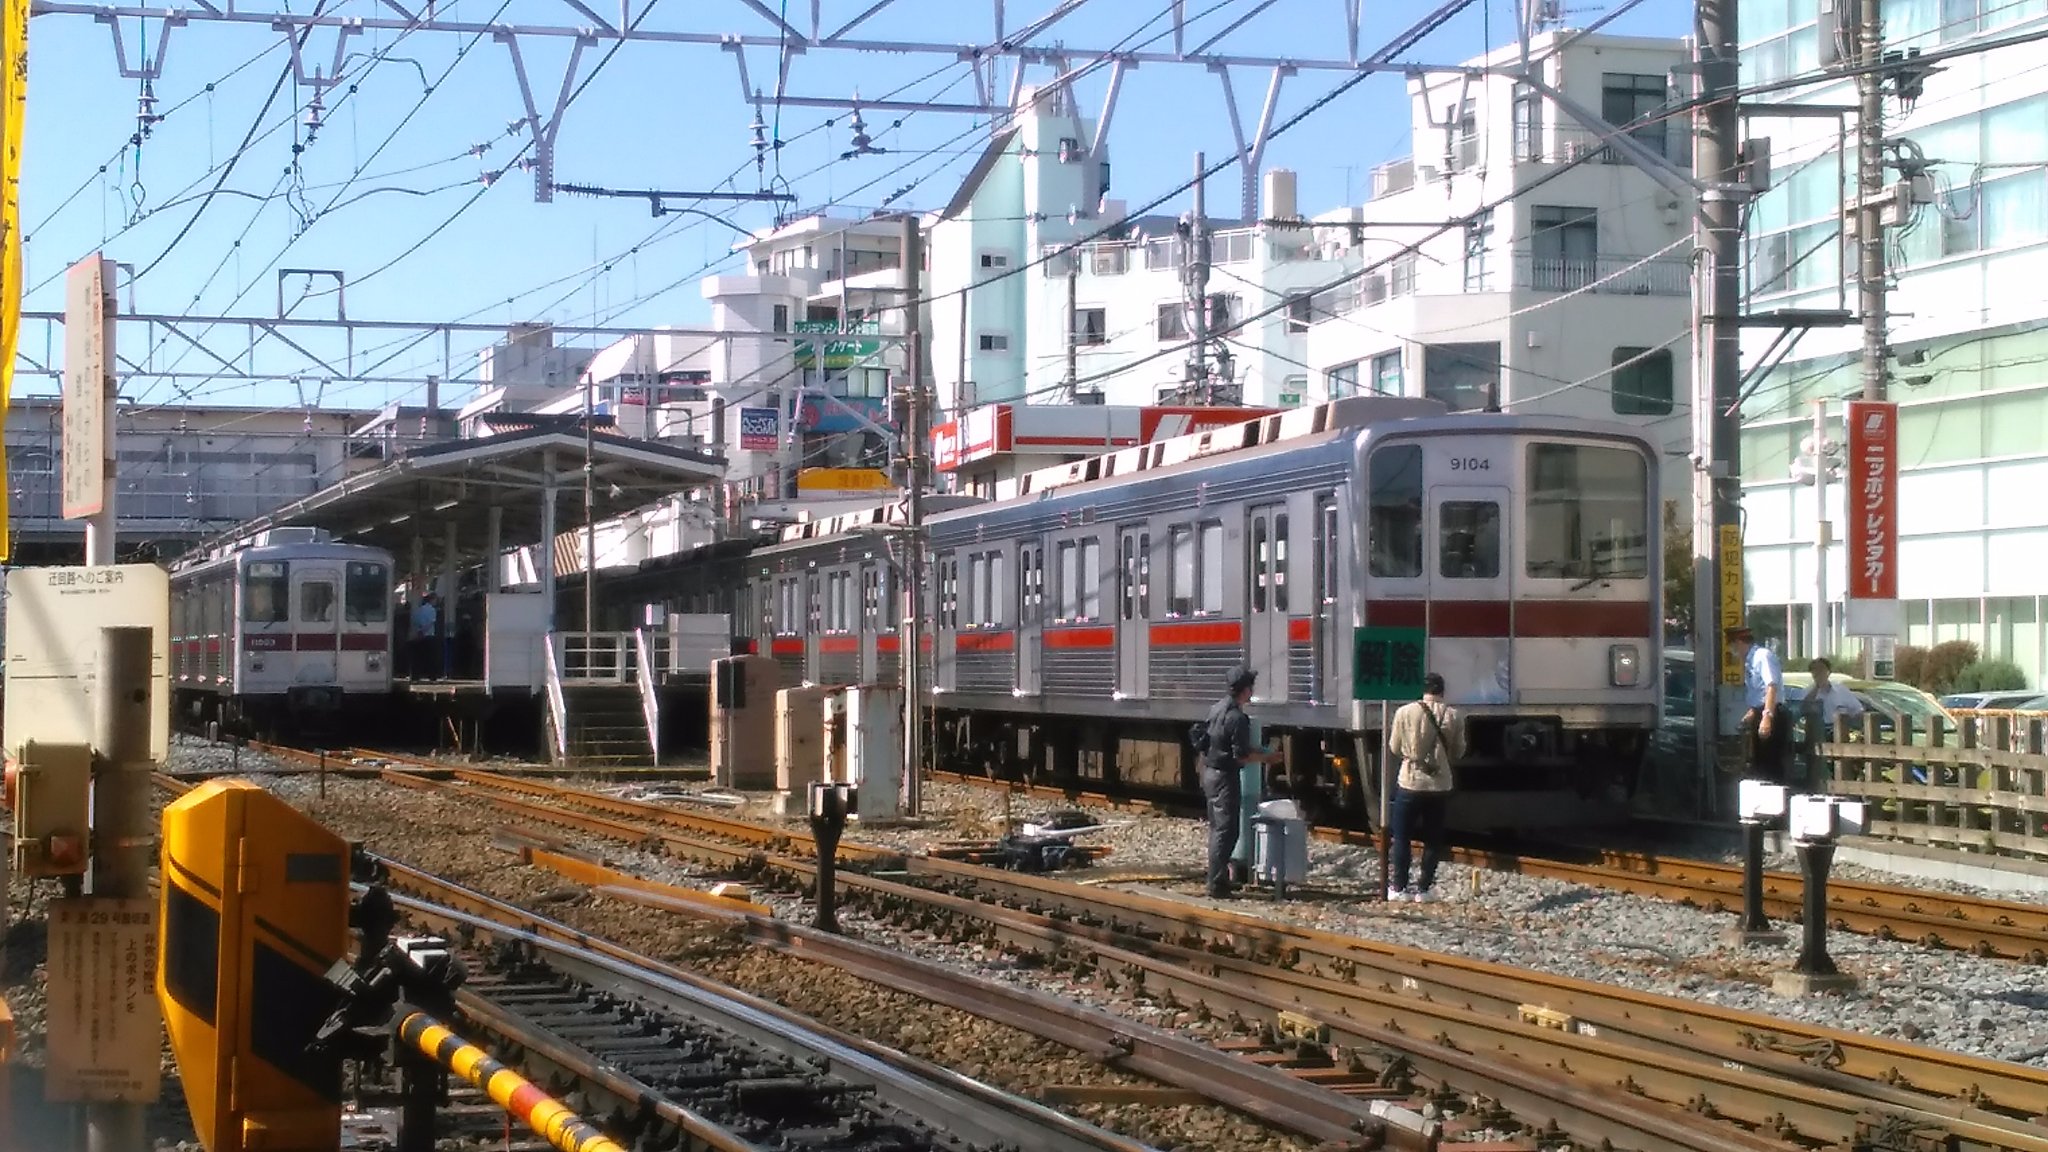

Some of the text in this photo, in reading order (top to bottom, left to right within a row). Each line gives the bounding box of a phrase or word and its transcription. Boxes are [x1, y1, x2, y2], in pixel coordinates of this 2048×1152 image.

[1450, 457, 1491, 472] 9104
[1864, 444, 1885, 593] ニッポンレンタカー
[1723, 530, 1741, 682] 防犯カメラ中
